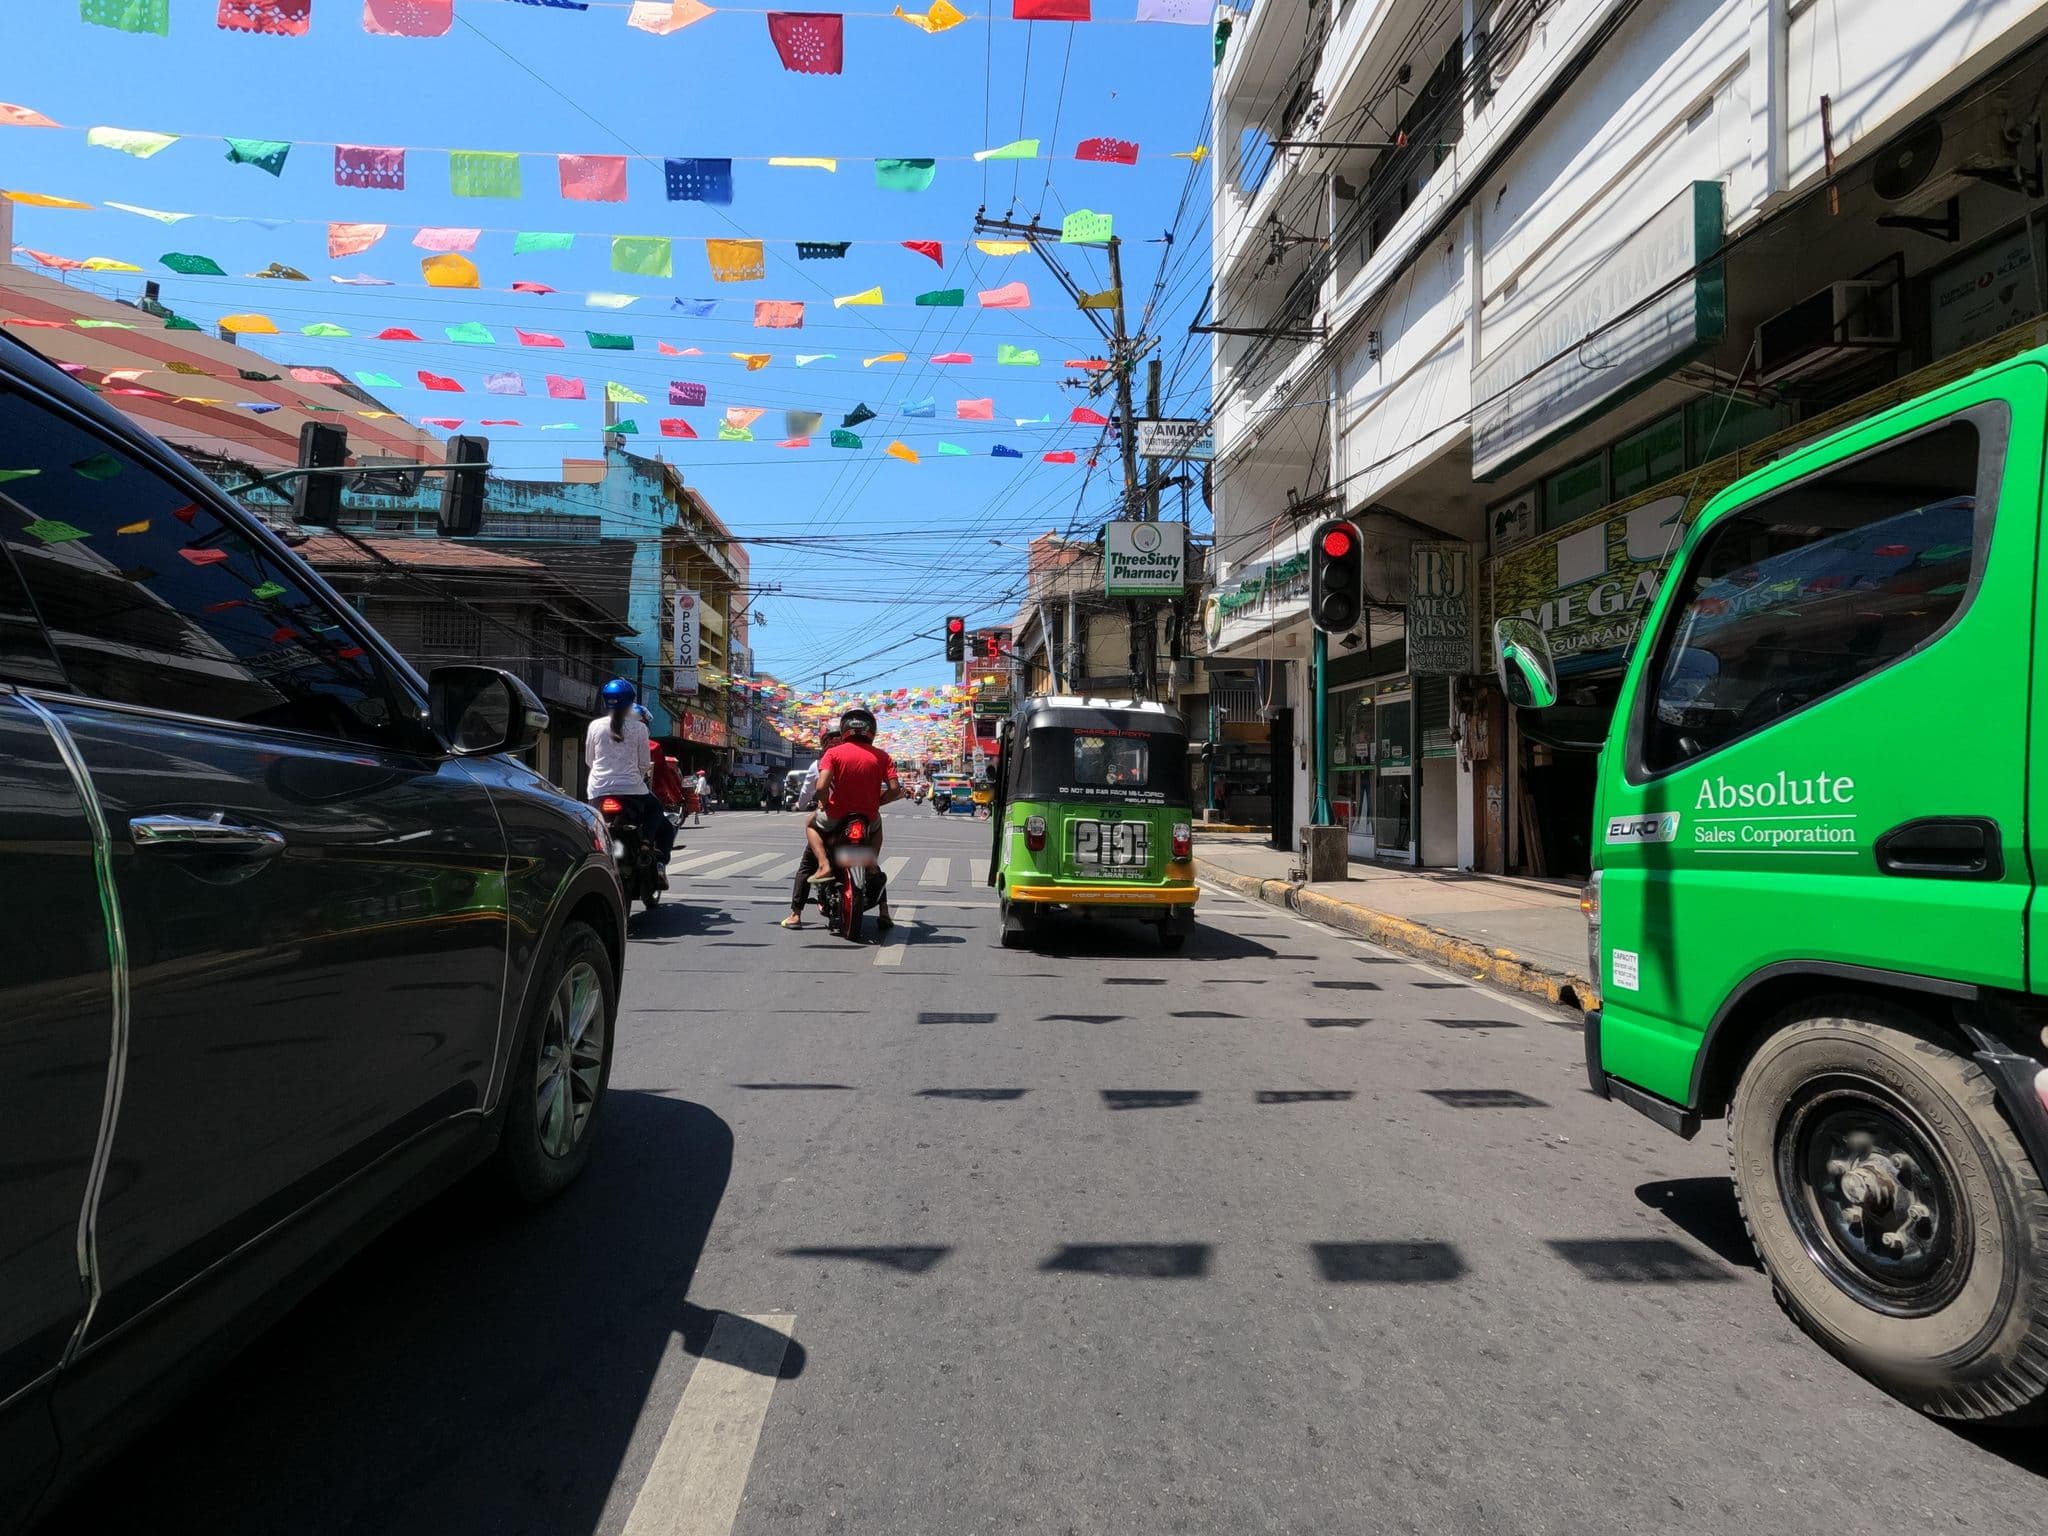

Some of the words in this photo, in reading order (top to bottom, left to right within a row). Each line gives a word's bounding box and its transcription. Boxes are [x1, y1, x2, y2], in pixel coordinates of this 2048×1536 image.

[1605, 211, 1690, 316] TRAVEL
[1111, 552, 1180, 568] ThreeSixty
[1113, 566, 1178, 581] Pharmacy
[1416, 551, 1465, 599] RJ
[1416, 599, 1466, 617] MEGA
[1416, 619, 1466, 638] GLASS
[680, 611, 692, 665] PBCOM
[1695, 771, 1855, 810] Absolute
[1100, 809, 1122, 819] TVS
[1610, 821, 1658, 836] EURO
[1695, 827, 1736, 843] Sales
[1741, 824, 1856, 846] Corporation
[1075, 871, 1124, 879] TAILARAN
